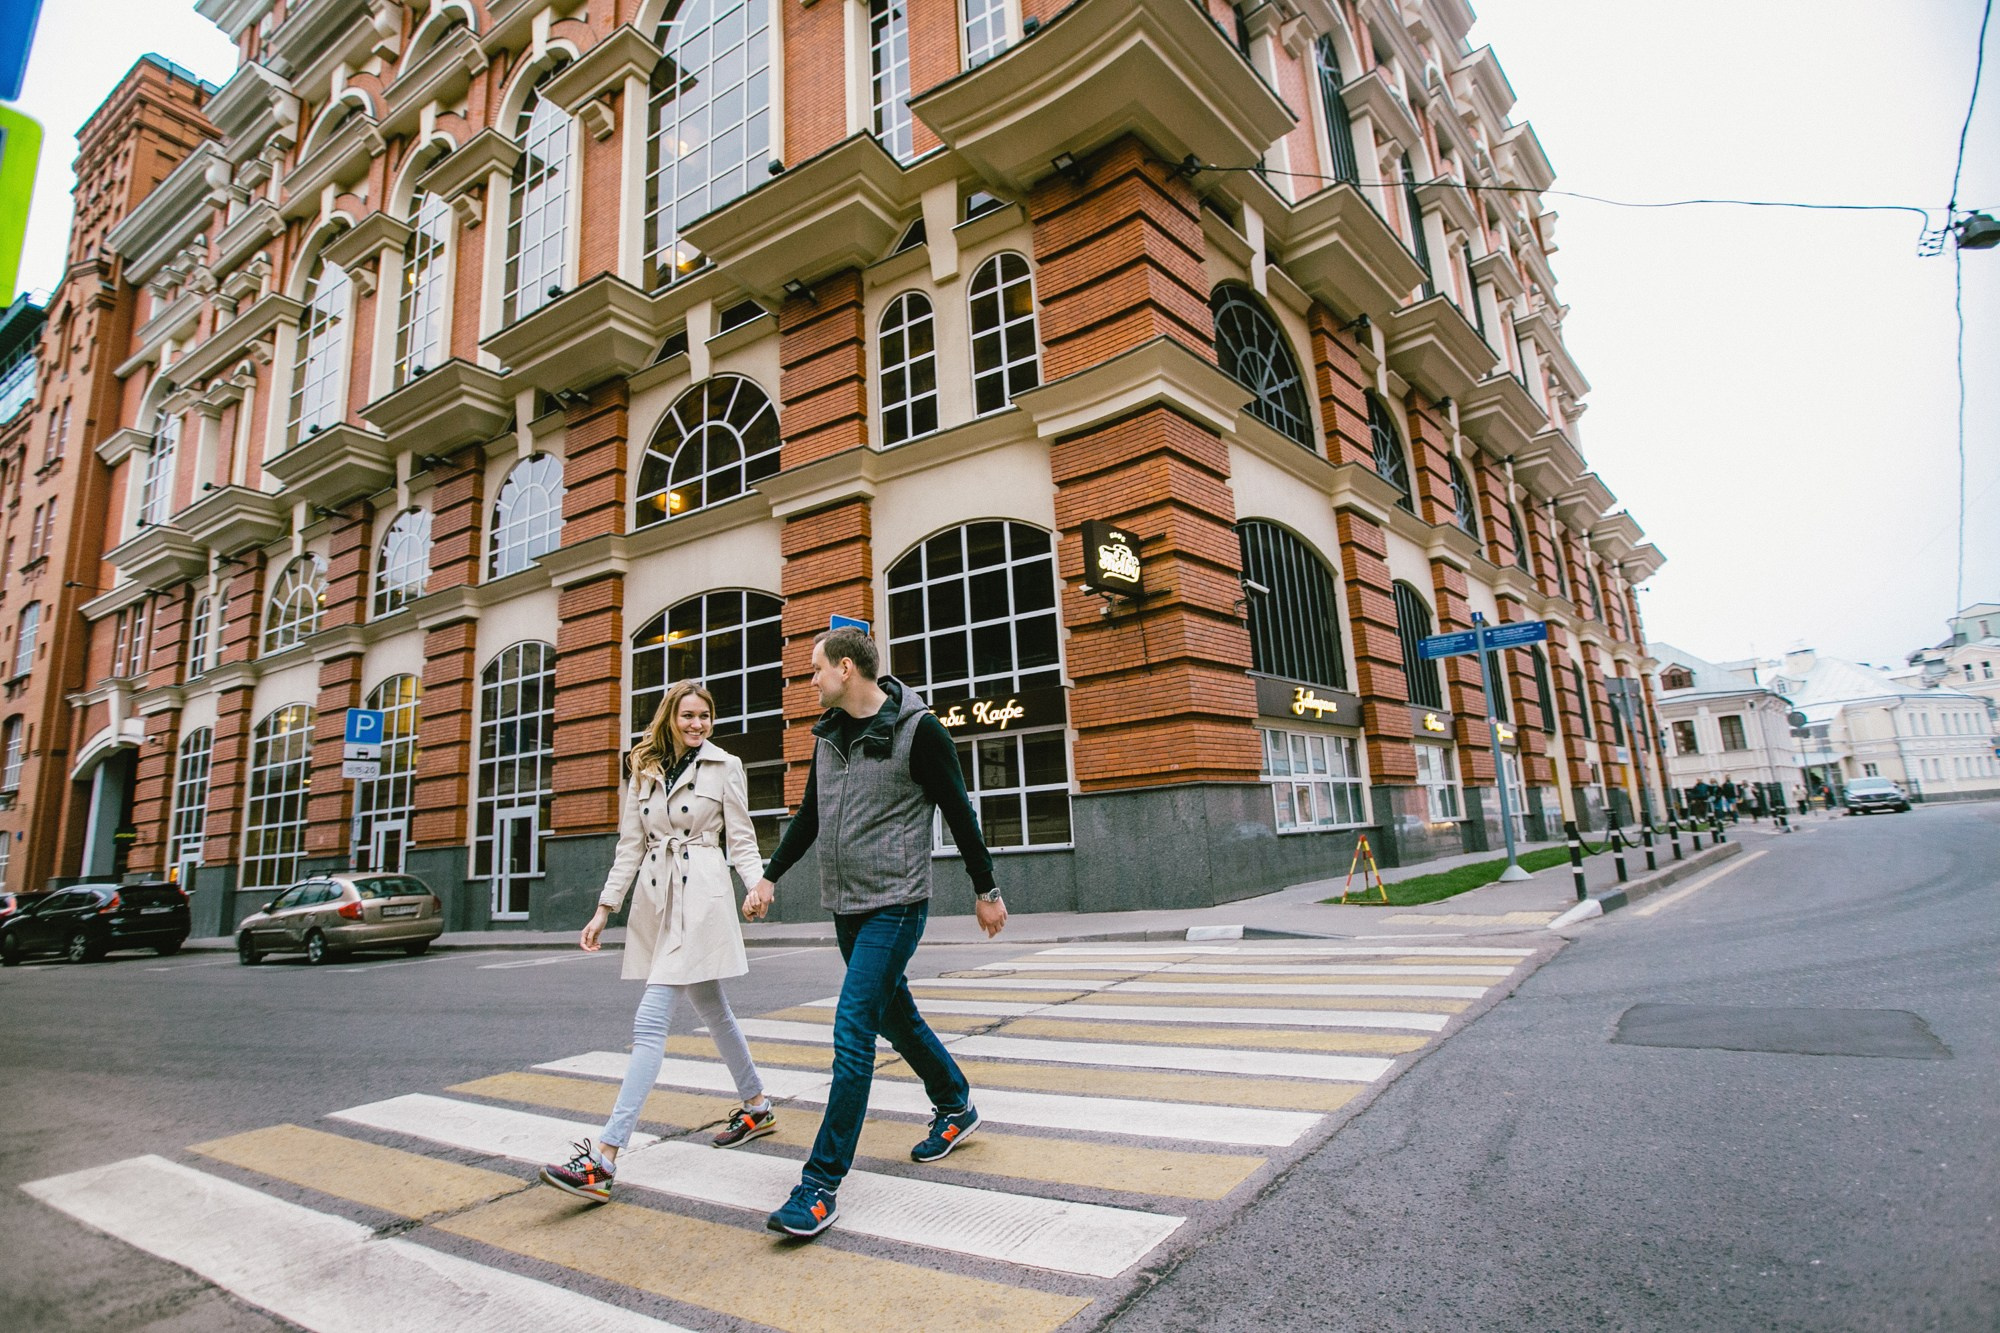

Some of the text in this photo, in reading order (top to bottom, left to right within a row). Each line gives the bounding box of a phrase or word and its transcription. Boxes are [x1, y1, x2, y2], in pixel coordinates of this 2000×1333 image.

[355, 714, 376, 738] P
[972, 699, 1025, 730] Кафе
[941, 1123, 960, 1142] N
[810, 1200, 828, 1223] N
